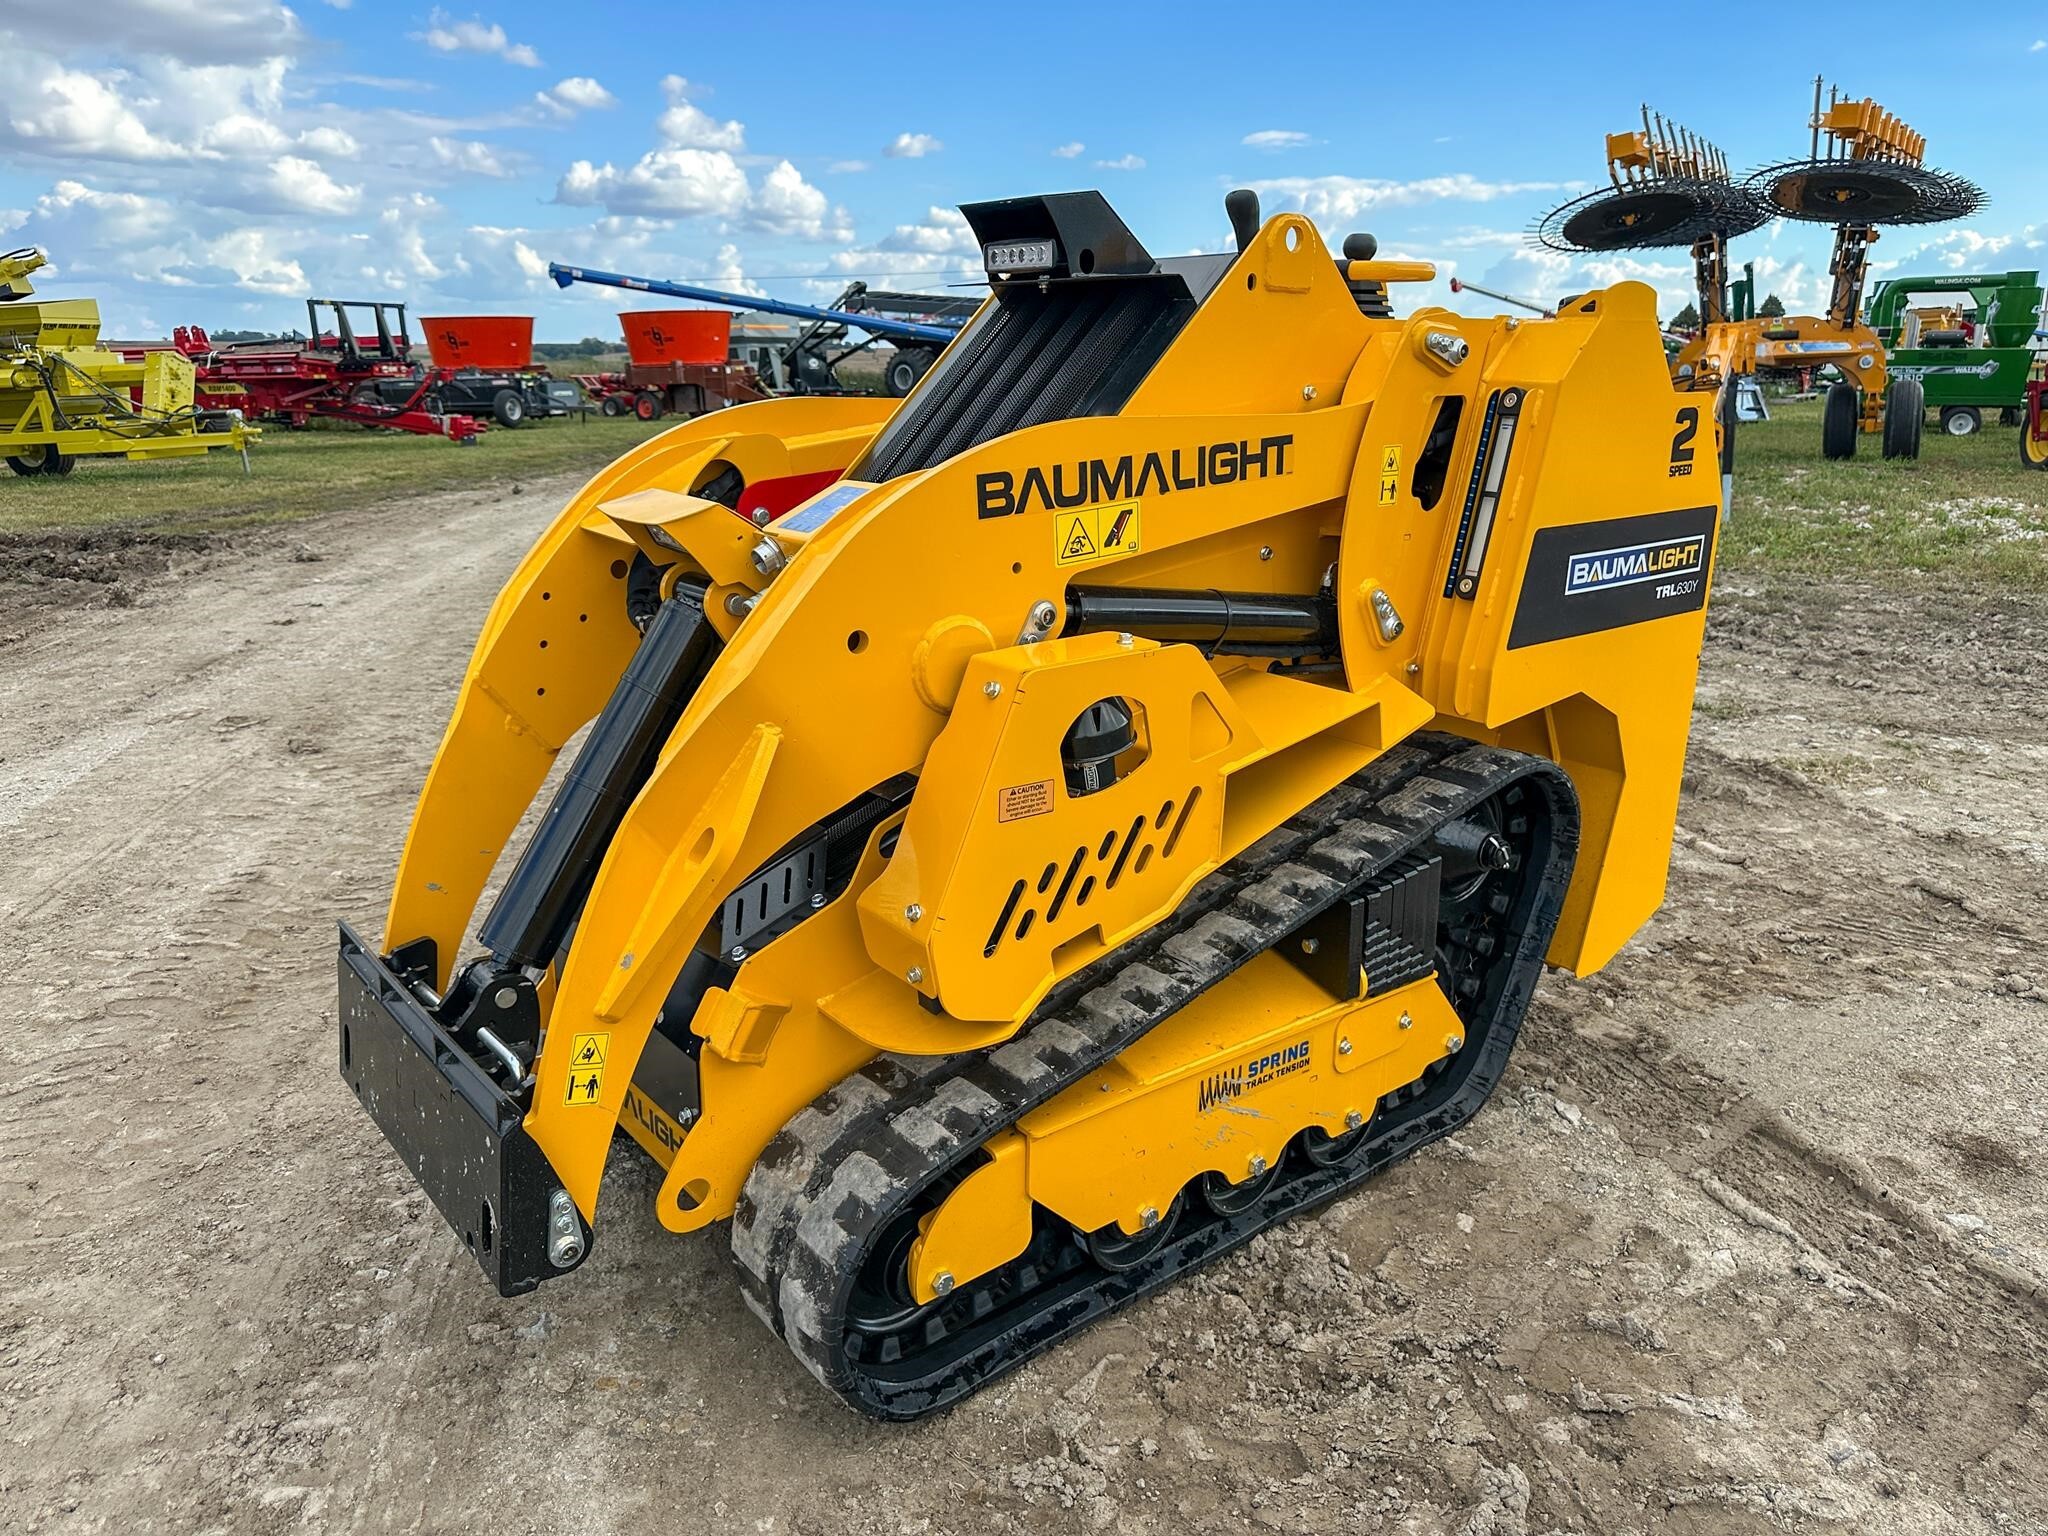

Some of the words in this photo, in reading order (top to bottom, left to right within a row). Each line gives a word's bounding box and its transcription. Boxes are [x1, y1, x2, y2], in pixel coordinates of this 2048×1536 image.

[1934, 277, 1982, 285] WALINGA.COM
[1670, 406, 1699, 463] 2
[976, 434, 1293, 520] BAUMALIGHT
[1669, 464, 1693, 477] SPEED
[1572, 544, 1699, 585] BAUMALIGHT
[1655, 579, 1699, 600] TRL630Y
[1017, 783, 1045, 795] CAUTION
[1246, 1072, 1274, 1090] TRACK
[1276, 1057, 1311, 1078] TENSION
[1248, 1040, 1310, 1078] SPRING
